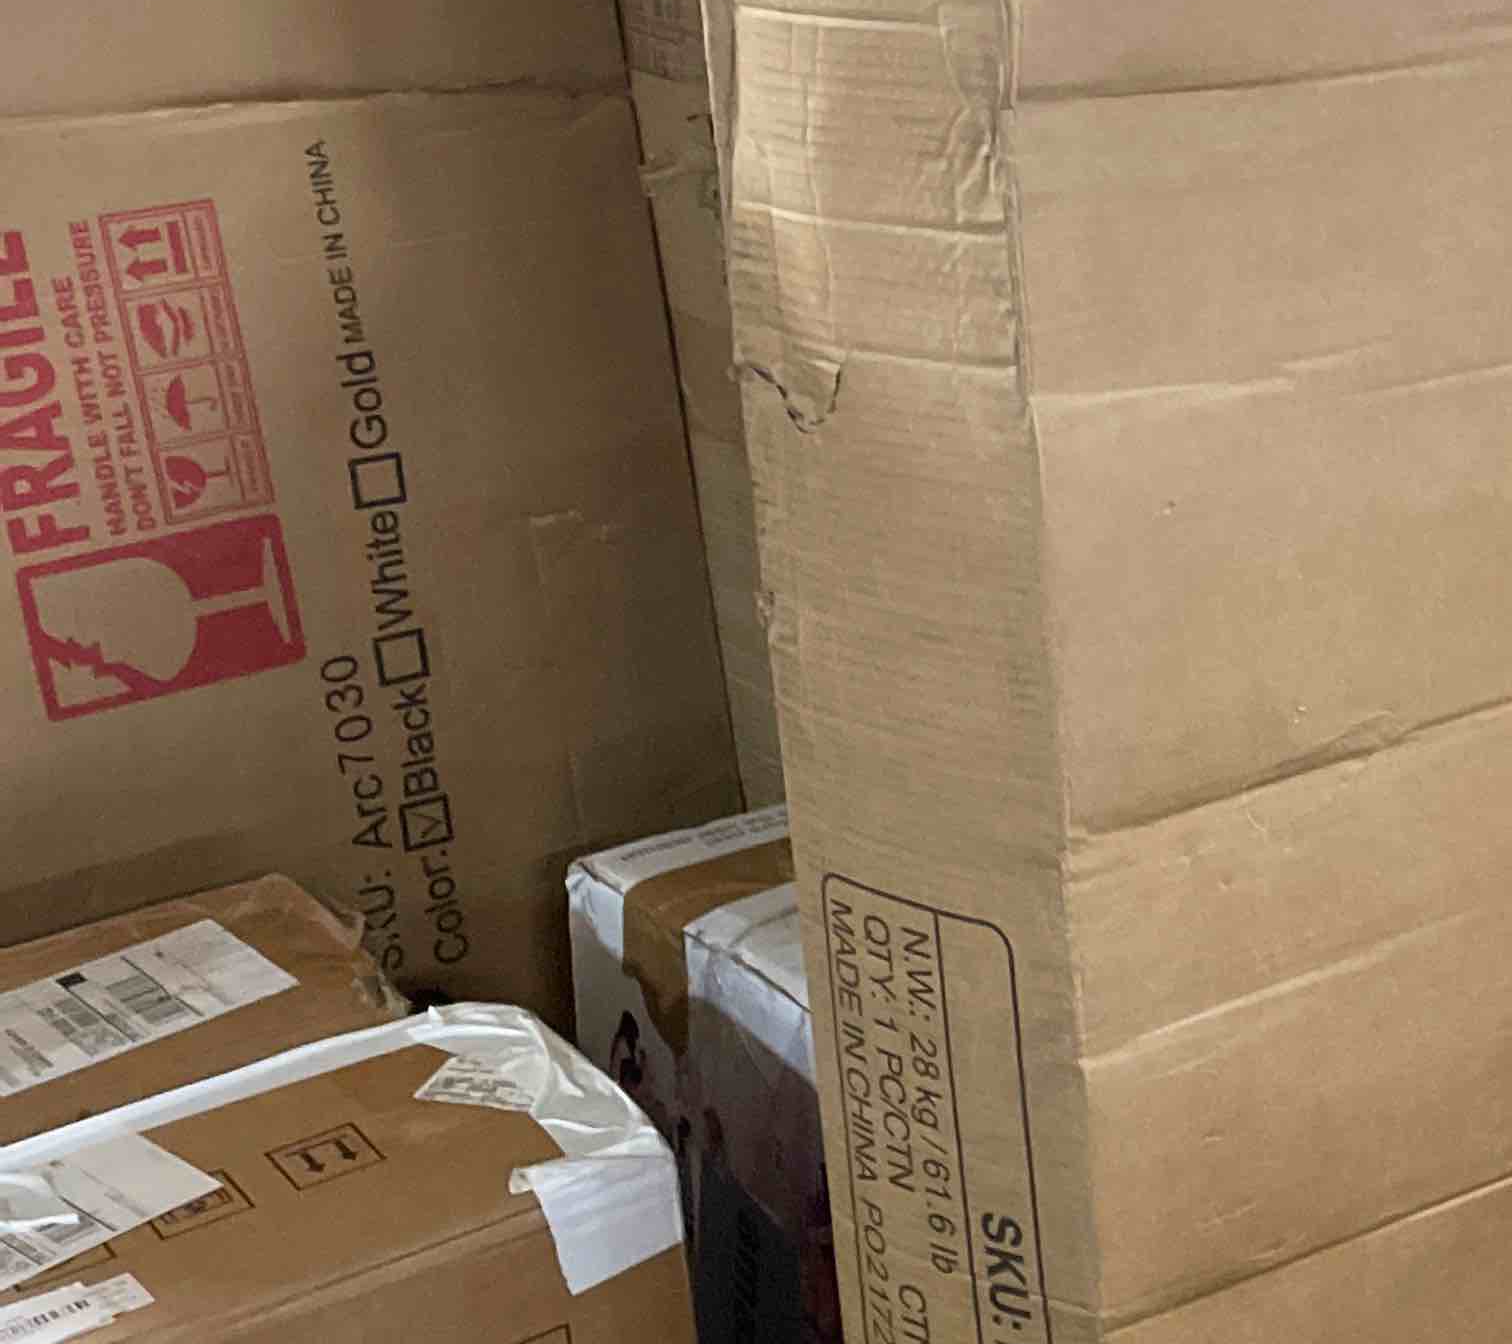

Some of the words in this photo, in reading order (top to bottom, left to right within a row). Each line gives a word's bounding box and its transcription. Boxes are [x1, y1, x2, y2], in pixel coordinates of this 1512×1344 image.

[303, 139, 341, 226] CHINA
[70, 221, 112, 344] PRESSURE
[325, 231, 346, 260] IN
[52, 276, 85, 349] CARE
[335, 266, 366, 345] MADE
[69, 356, 104, 425] WITH
[100, 351, 127, 398] NOT
[336, 348, 388, 450] Gold
[111, 403, 140, 459] FALL
[87, 431, 128, 536] HANDLE
[366, 510, 410, 631] White
[393, 682, 440, 799] Black
[830, 899, 863, 1017] MADE
[864, 915, 897, 1004] QTY:
[842, 1021, 868, 1064] IN
[873, 1018, 900, 1033] 1
[909, 1032, 941, 1081] 28
[846, 1067, 879, 1182] CHINA
[875, 1045, 915, 1192] PC/CTN
[911, 1086, 943, 1131] kg
[923, 1159, 956, 1237] 61.6
[929, 1242, 959, 1275] lb
[981, 1212, 1032, 1332] SKU:
